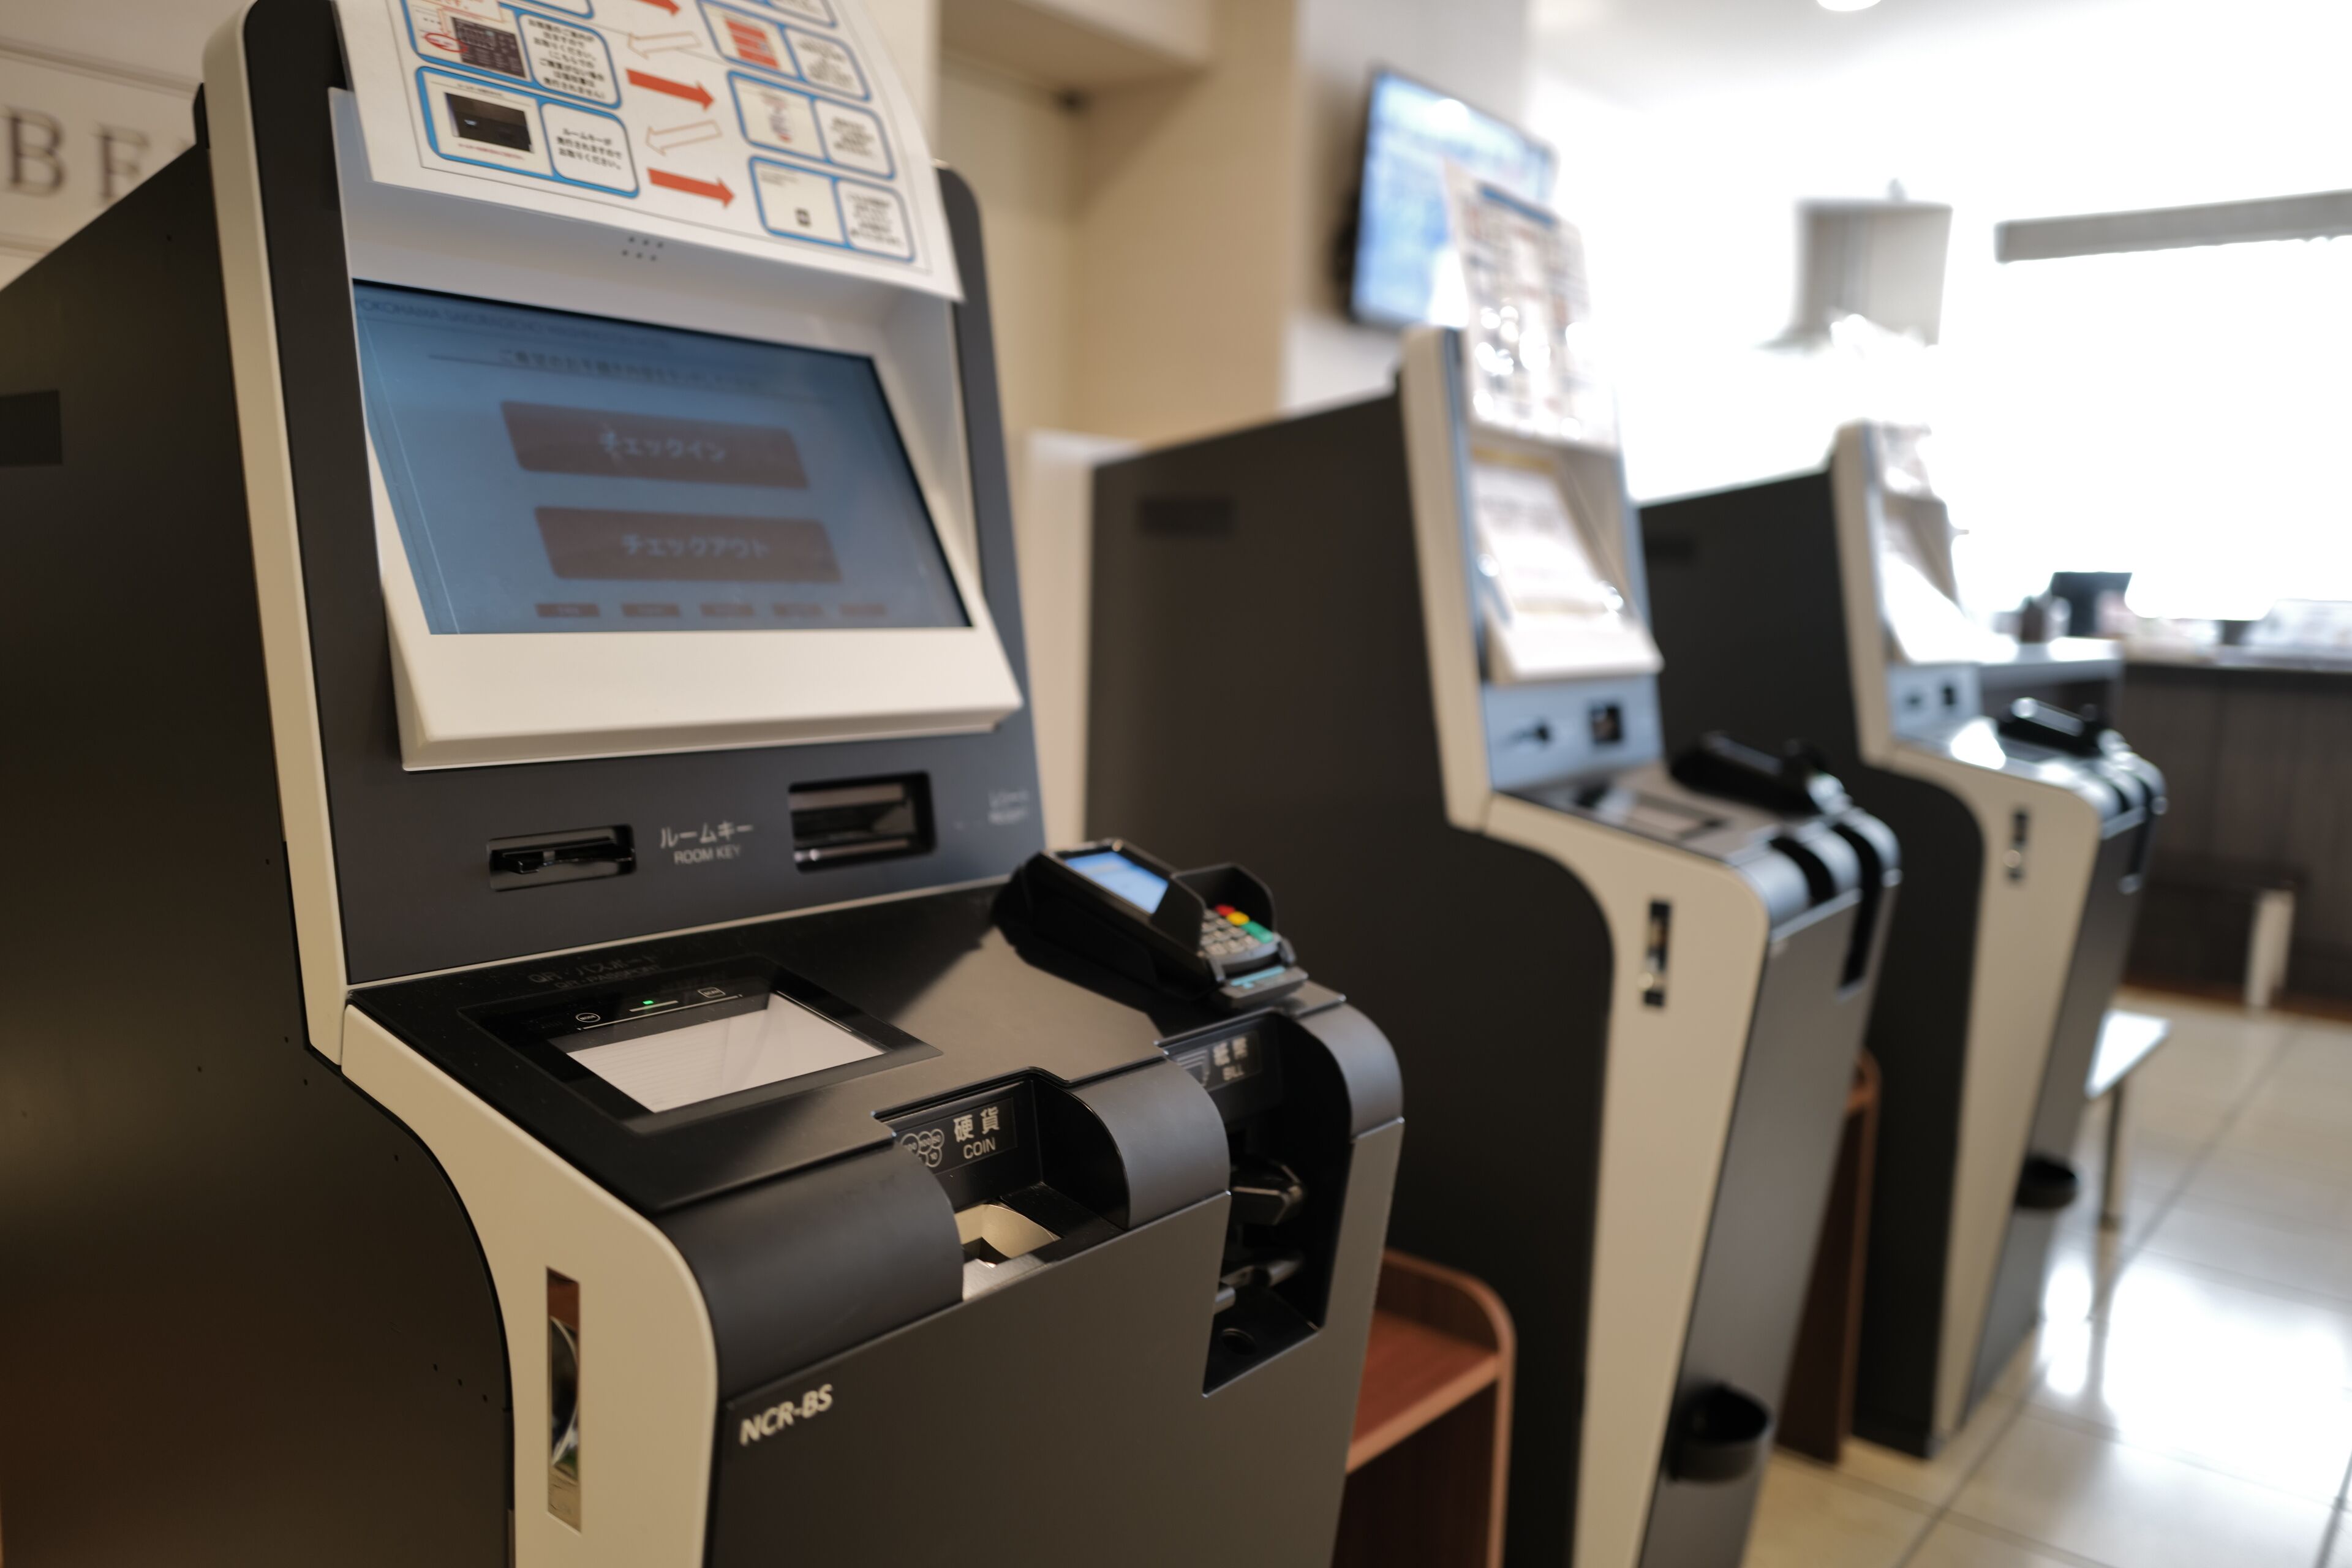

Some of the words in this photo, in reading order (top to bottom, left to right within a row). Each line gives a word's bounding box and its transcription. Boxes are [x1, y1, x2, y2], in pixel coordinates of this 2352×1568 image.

[599, 430, 727, 462] チェックイン
[621, 533, 771, 559] チェックアウト
[660, 821, 754, 848] ルームキー
[673, 846, 714, 865] ROOM
[716, 843, 741, 859] KEY
[953, 1106, 1000, 1142] 硬貨
[963, 1137, 996, 1159] COIN
[739, 1383, 834, 1446] NCR-BS
